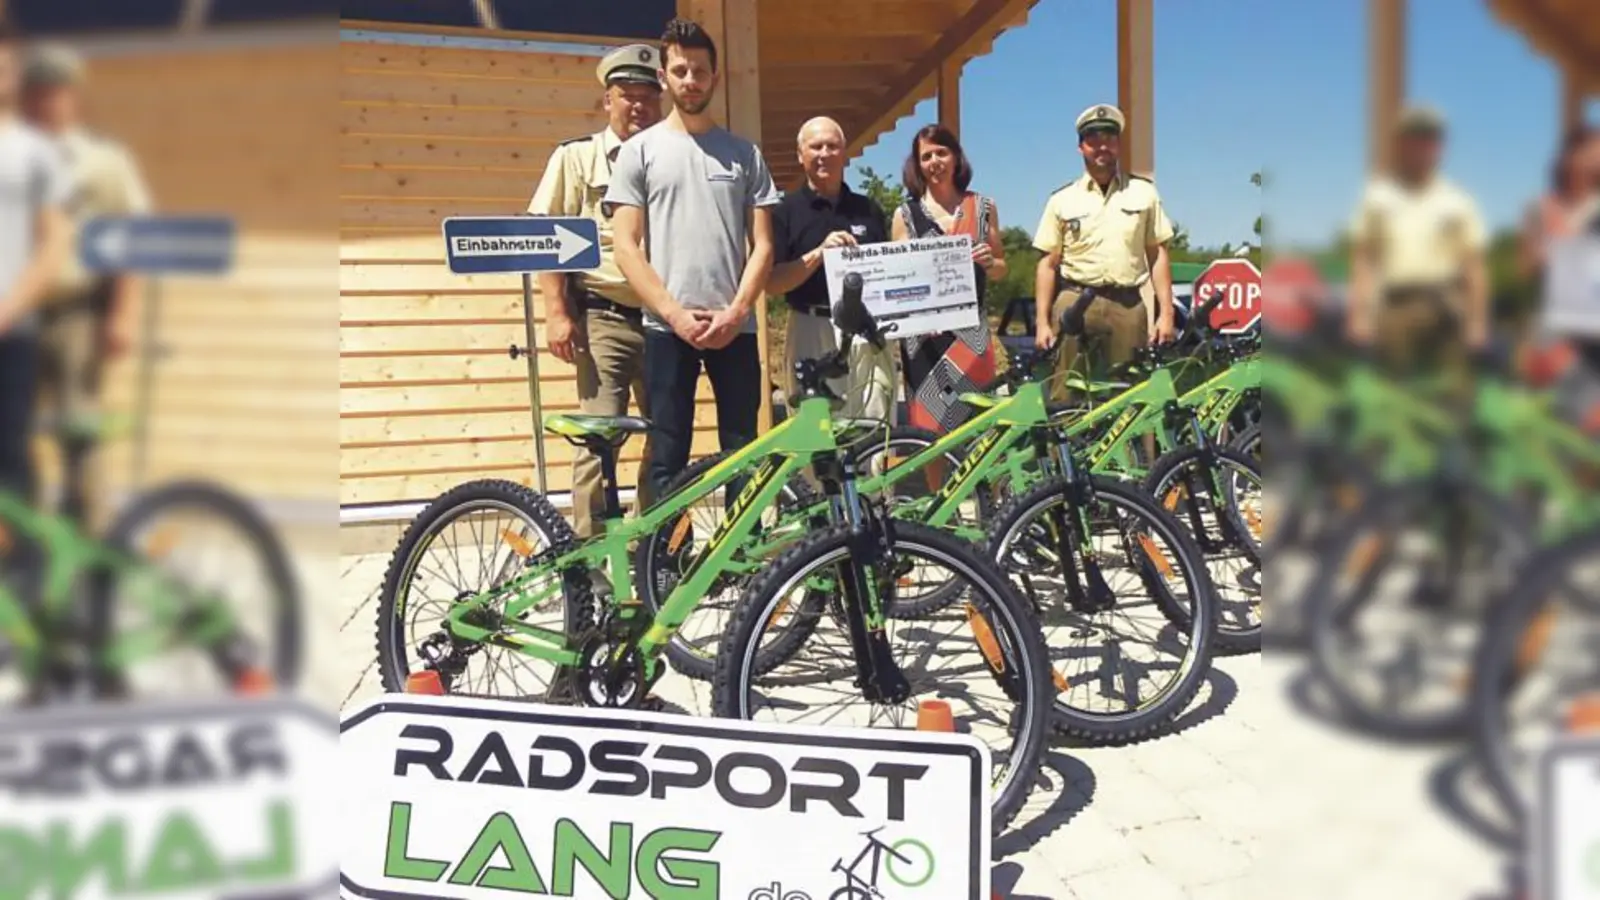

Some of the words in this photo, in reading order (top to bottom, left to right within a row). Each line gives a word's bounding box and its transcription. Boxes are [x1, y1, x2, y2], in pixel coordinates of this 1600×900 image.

[456, 238, 562, 252] Einbahnstraße
[1198, 282, 1261, 309] STOP
[943, 427, 1001, 498] CUBE
[1090, 404, 1139, 464] CUBE
[709, 458, 775, 549] CUBE
[393, 724, 929, 821] RADSPORT
[384, 800, 723, 900] LANG
